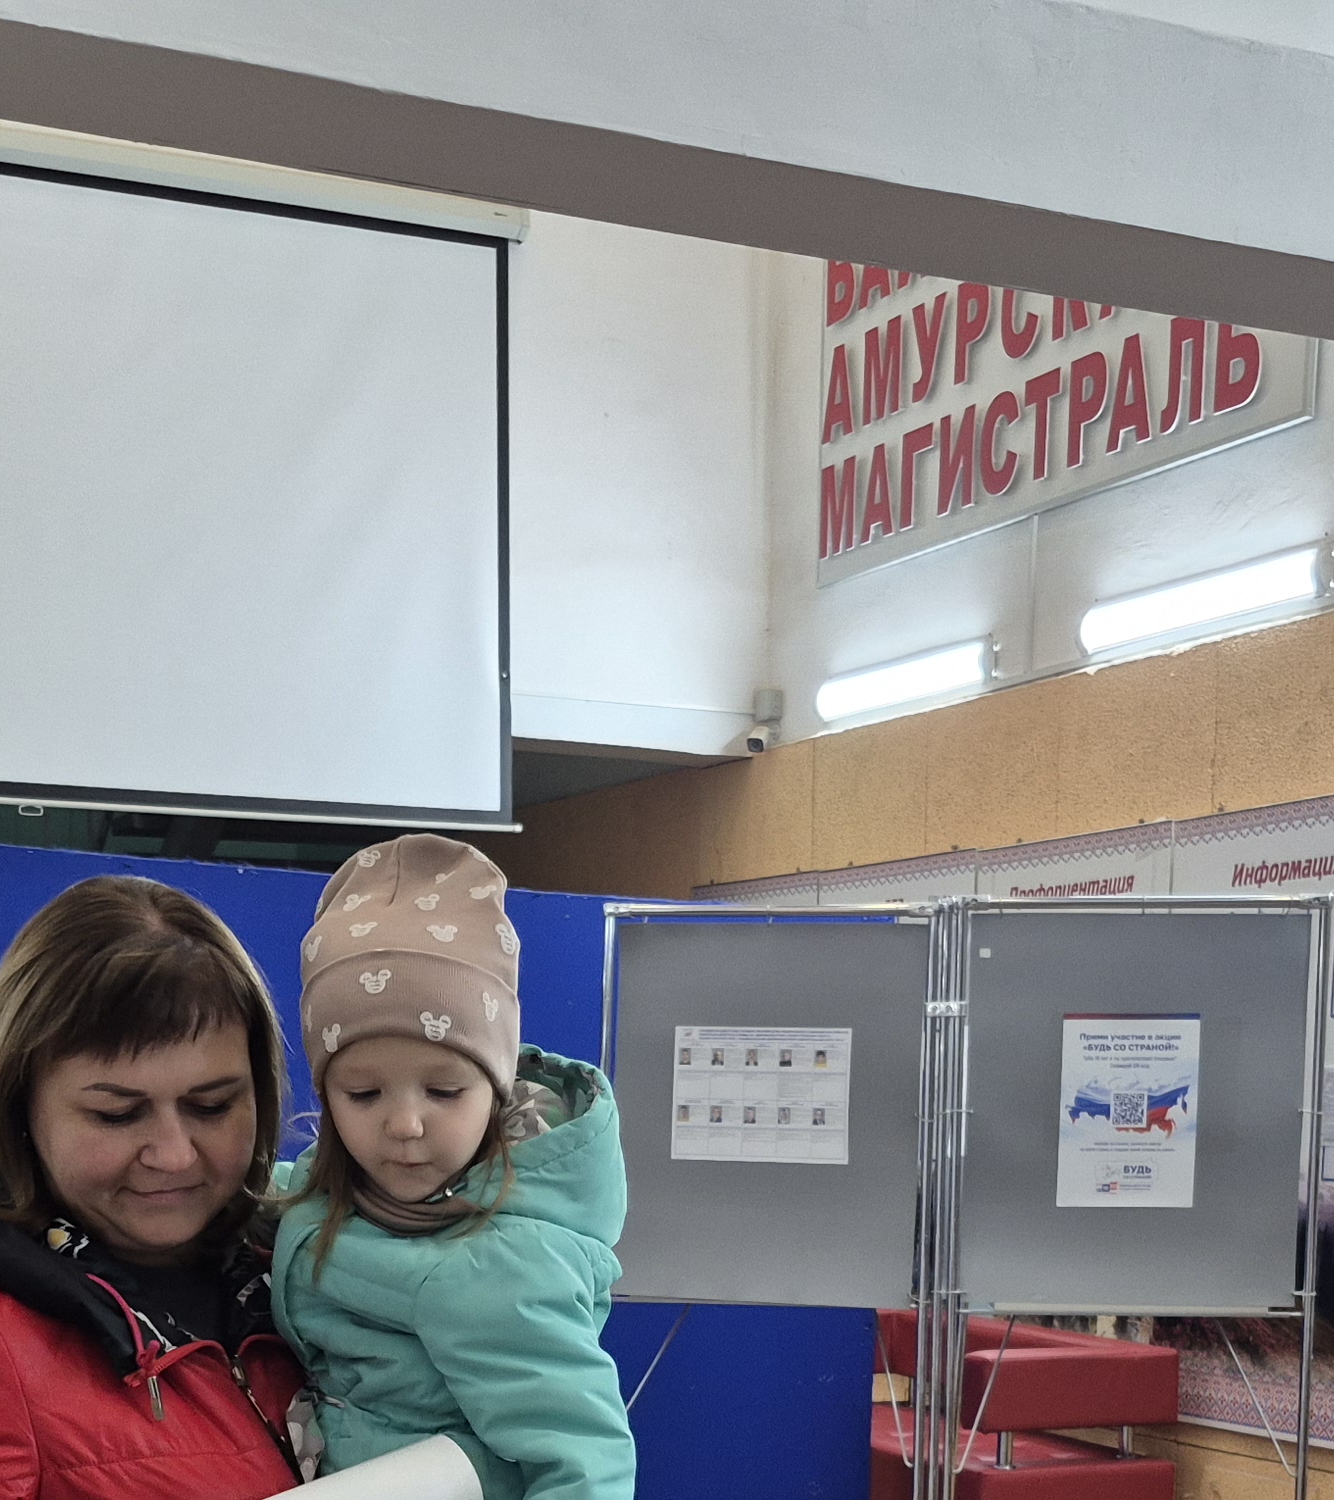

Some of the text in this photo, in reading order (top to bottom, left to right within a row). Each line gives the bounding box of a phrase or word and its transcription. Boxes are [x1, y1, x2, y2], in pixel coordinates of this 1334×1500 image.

[820, 320, 1263, 561] МАГИСТРАЛЬ
[822, 283, 1116, 445] АМУРС
[1124, 1165, 1151, 1174] БУДЬ
